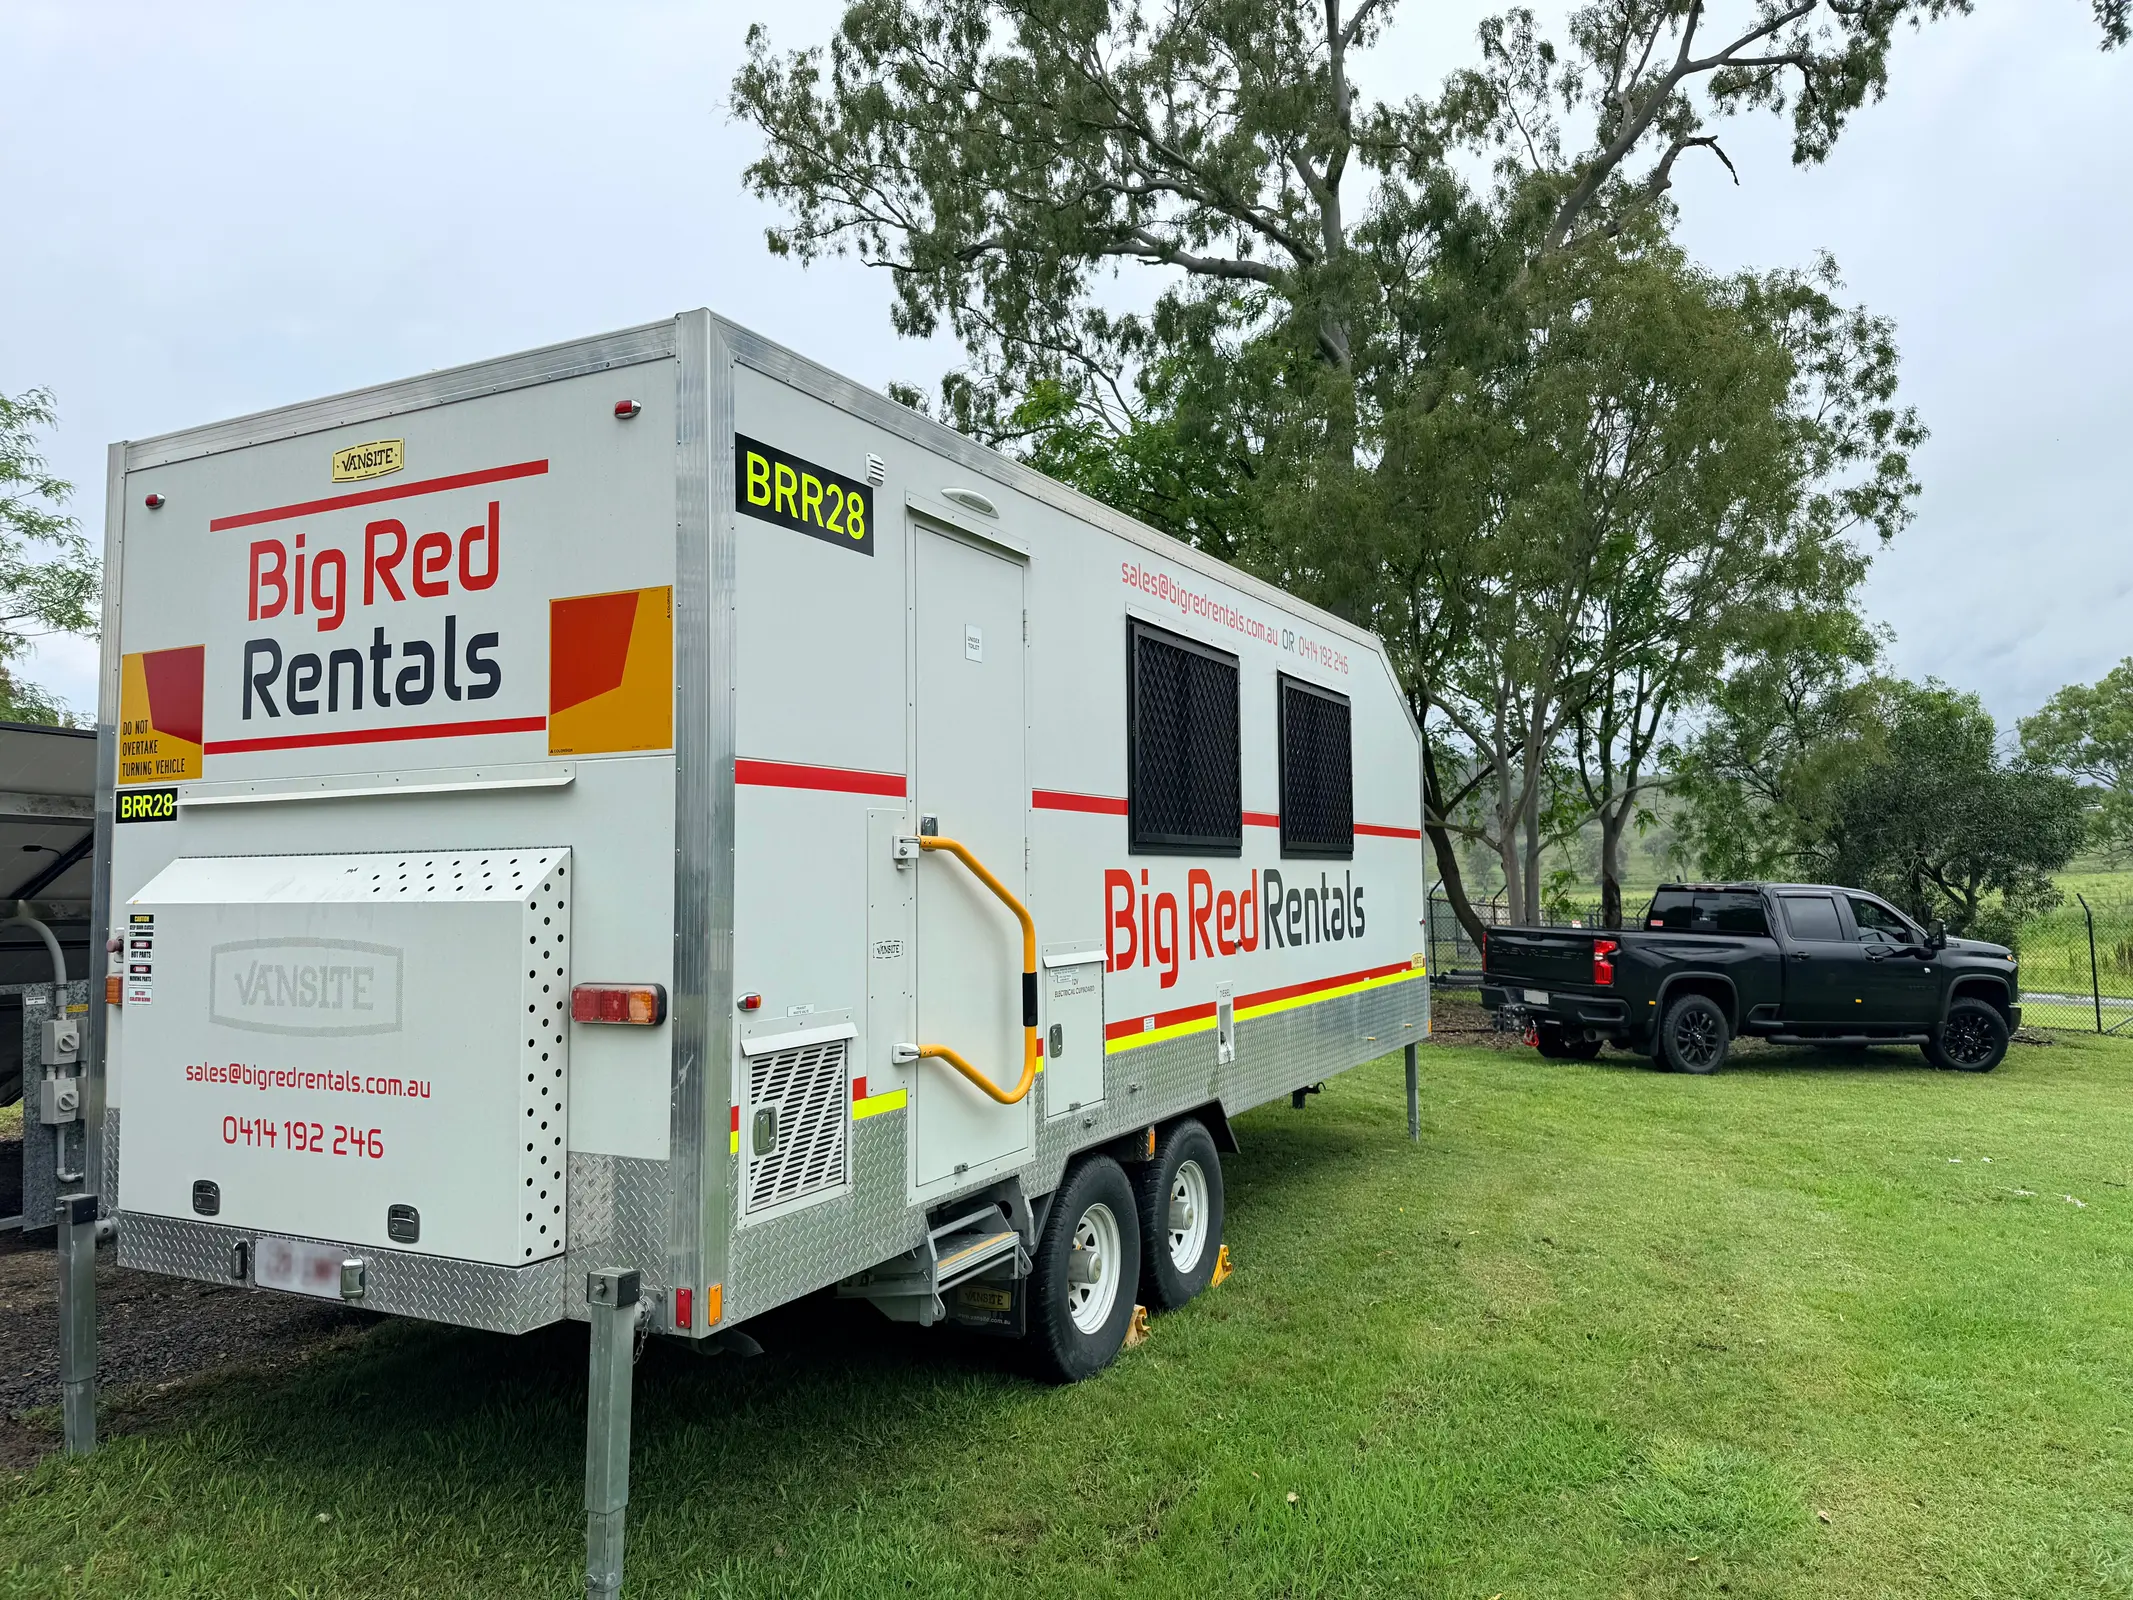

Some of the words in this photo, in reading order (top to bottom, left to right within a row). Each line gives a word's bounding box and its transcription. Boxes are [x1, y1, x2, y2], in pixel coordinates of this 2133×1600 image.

[342, 447, 393, 471] VANSITE
[747, 450, 865, 540] BRR28
[248, 533, 347, 632] Big
[363, 501, 499, 605] Red
[1121, 562, 1278, 646] sales@bigredrentals.com.au
[1282, 628, 1295, 653] OR
[1298, 636, 1318, 662] 0414
[1319, 644, 1332, 668] 192
[1334, 650, 1349, 675] 246
[243, 615, 501, 720] Rentals
[122, 721, 132, 736] DO
[135, 719, 149, 735] NOT
[122, 740, 159, 756] OVERTAKE
[122, 760, 152, 777] TURNING
[155, 758, 186, 775] VEHICLE
[121, 793, 174, 818] BRR28
[1105, 868, 1179, 989] Big
[1187, 868, 1258, 961] Red
[1263, 868, 1365, 950] Rentals
[876, 942, 900, 956] VANSITE
[234, 960, 375, 1011] VANSITE
[185, 1062, 432, 1099] sales@bigredrentals.com.au
[222, 1115, 278, 1149] 0414
[284, 1121, 324, 1154] 192
[333, 1124, 384, 1159] 246
[965, 1290, 1004, 1306] VANSITE
